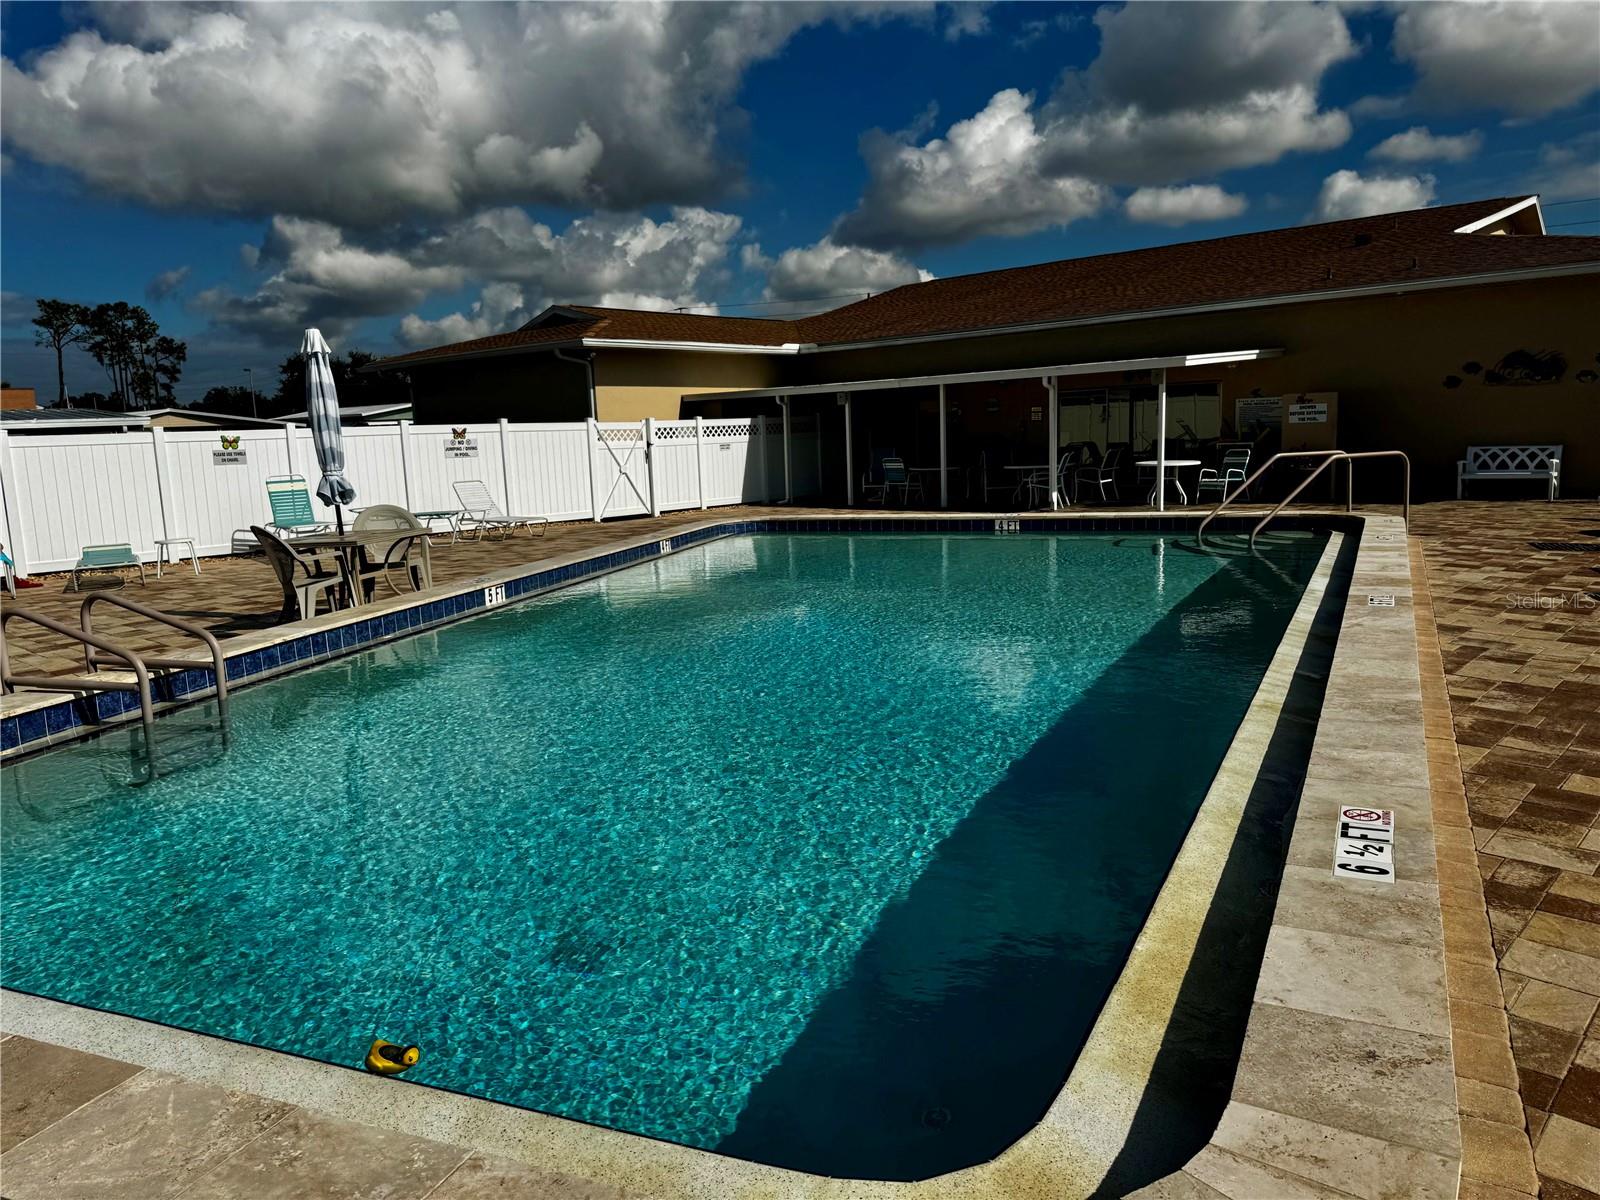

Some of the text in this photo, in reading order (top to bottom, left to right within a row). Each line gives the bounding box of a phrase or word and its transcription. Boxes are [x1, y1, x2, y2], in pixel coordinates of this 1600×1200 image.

[998, 520, 1020, 532] 4 FT
[488, 584, 505, 604] 5 FT
[1340, 822, 1390, 843] FT
[1336, 863, 1390, 876] 6
